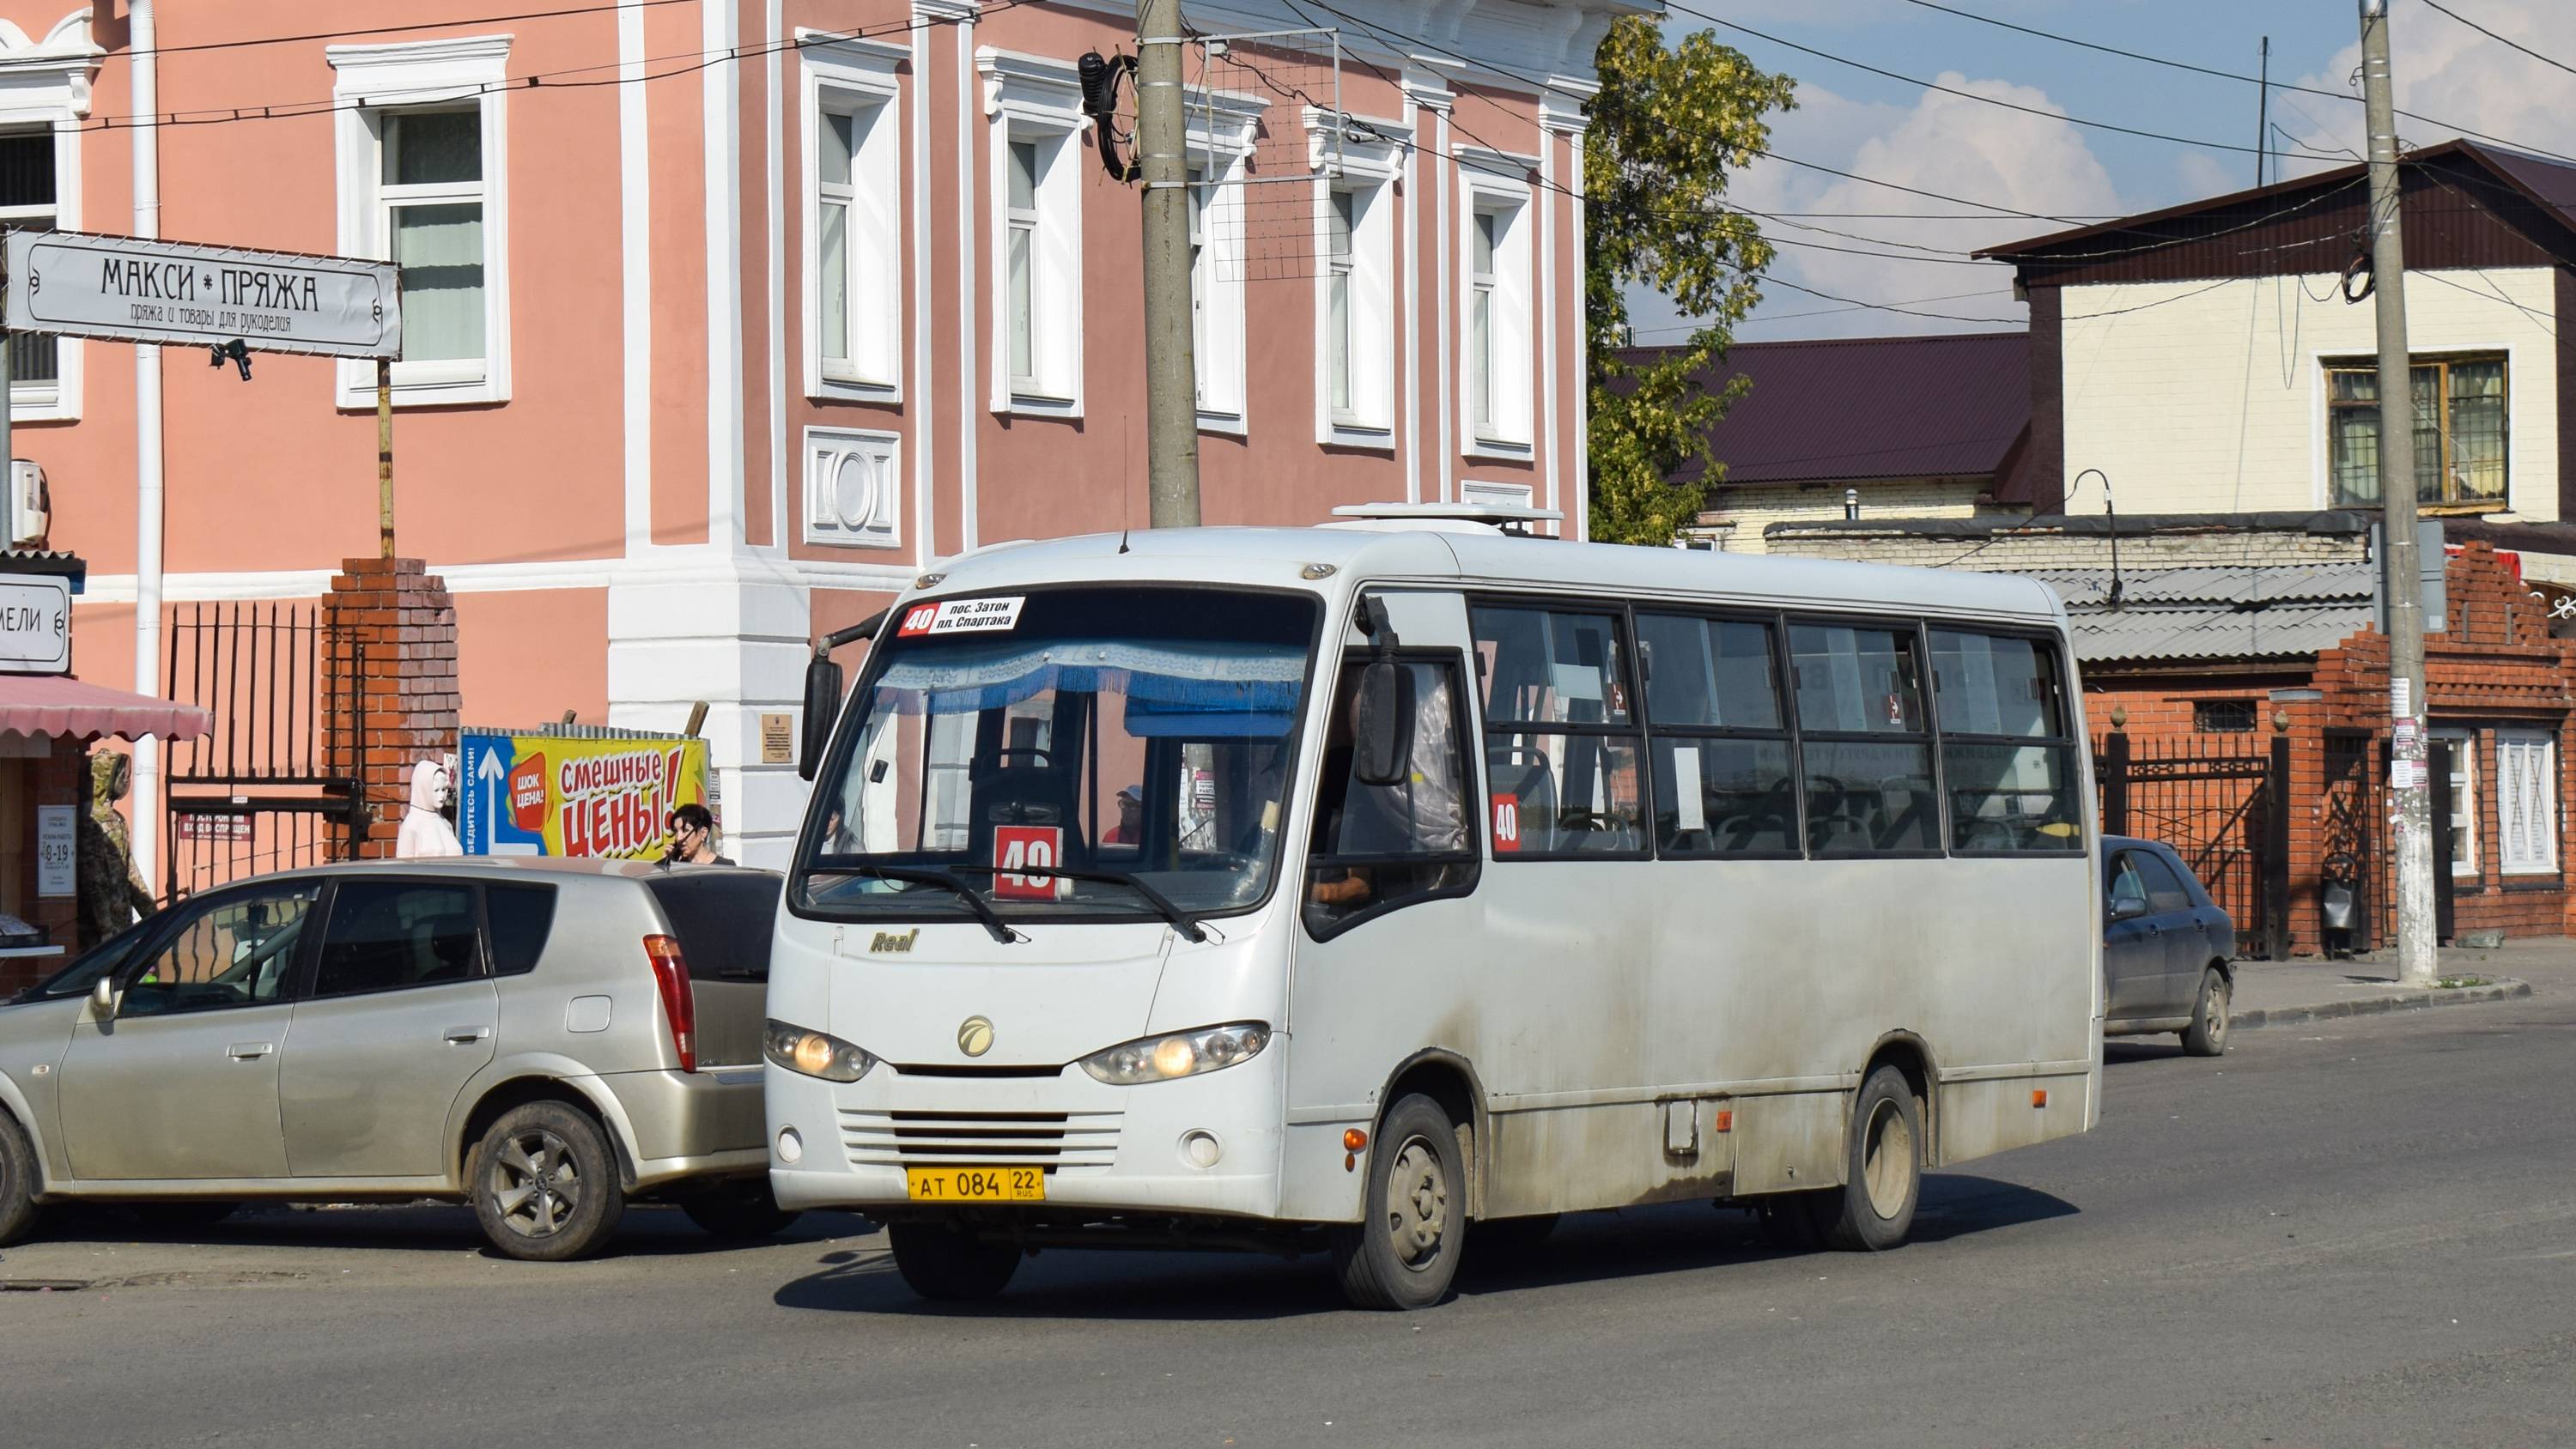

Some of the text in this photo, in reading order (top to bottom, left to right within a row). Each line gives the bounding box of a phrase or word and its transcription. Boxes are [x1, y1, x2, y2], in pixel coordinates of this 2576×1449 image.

[101, 258, 319, 312] МАКСИ ПРЯЖА
[131, 303, 163, 324] пряжа
[179, 307, 215, 330] товары
[218, 311, 237, 329] для
[240, 312, 291, 333] рукоделия
[905, 602, 1010, 630] 40 пос. Затон
[936, 615, 1012, 628] пл. Спартака
[518, 773, 539, 790] ШОК
[517, 791, 544, 808] ЦЕНА!
[467, 789, 476, 855] БЕДИТЕСЬ
[1496, 803, 1516, 841] 40
[1001, 840, 1052, 888] 40
[870, 928, 920, 952] Real
[957, 1172, 999, 1196] 084
[1012, 1171, 1035, 1189] 22
